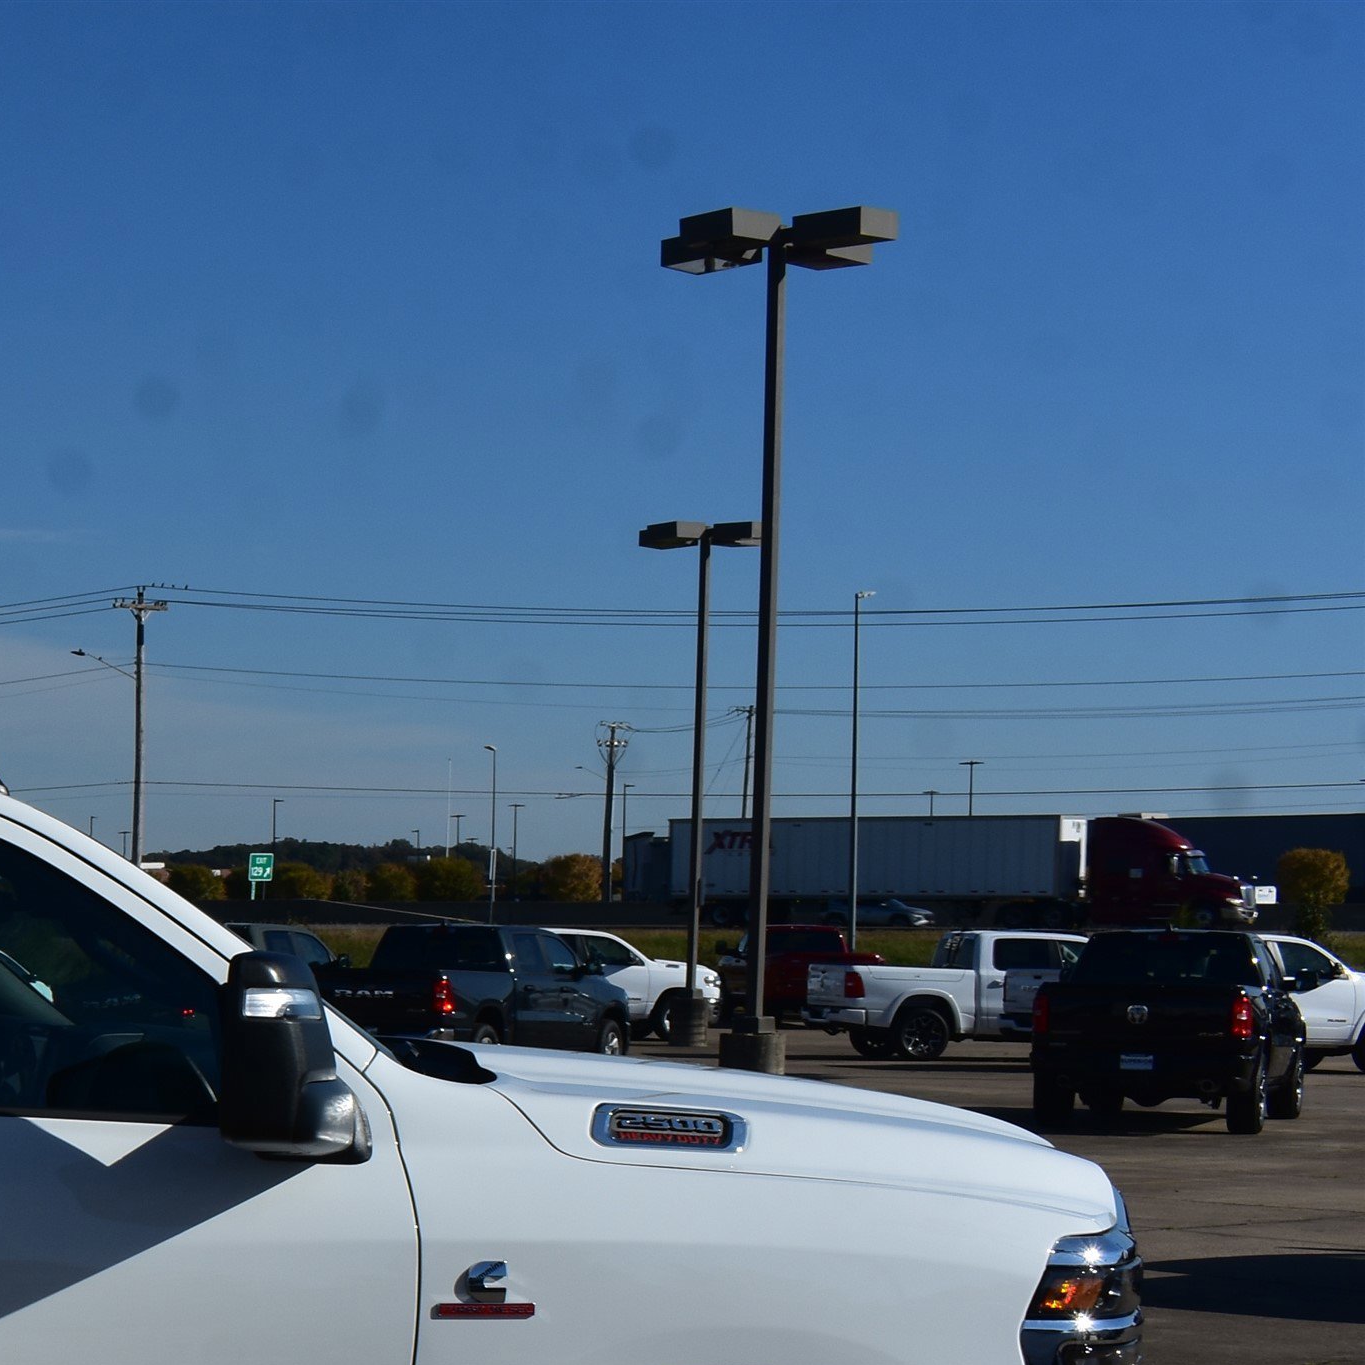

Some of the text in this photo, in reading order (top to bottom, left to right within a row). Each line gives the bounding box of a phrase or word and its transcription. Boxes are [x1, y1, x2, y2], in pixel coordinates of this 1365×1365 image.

[704, 830, 772, 855] XTR
[251, 866, 263, 876] 129
[615, 1114, 722, 1134] 2500
[619, 1131, 722, 1146] HEAVY DUTY
